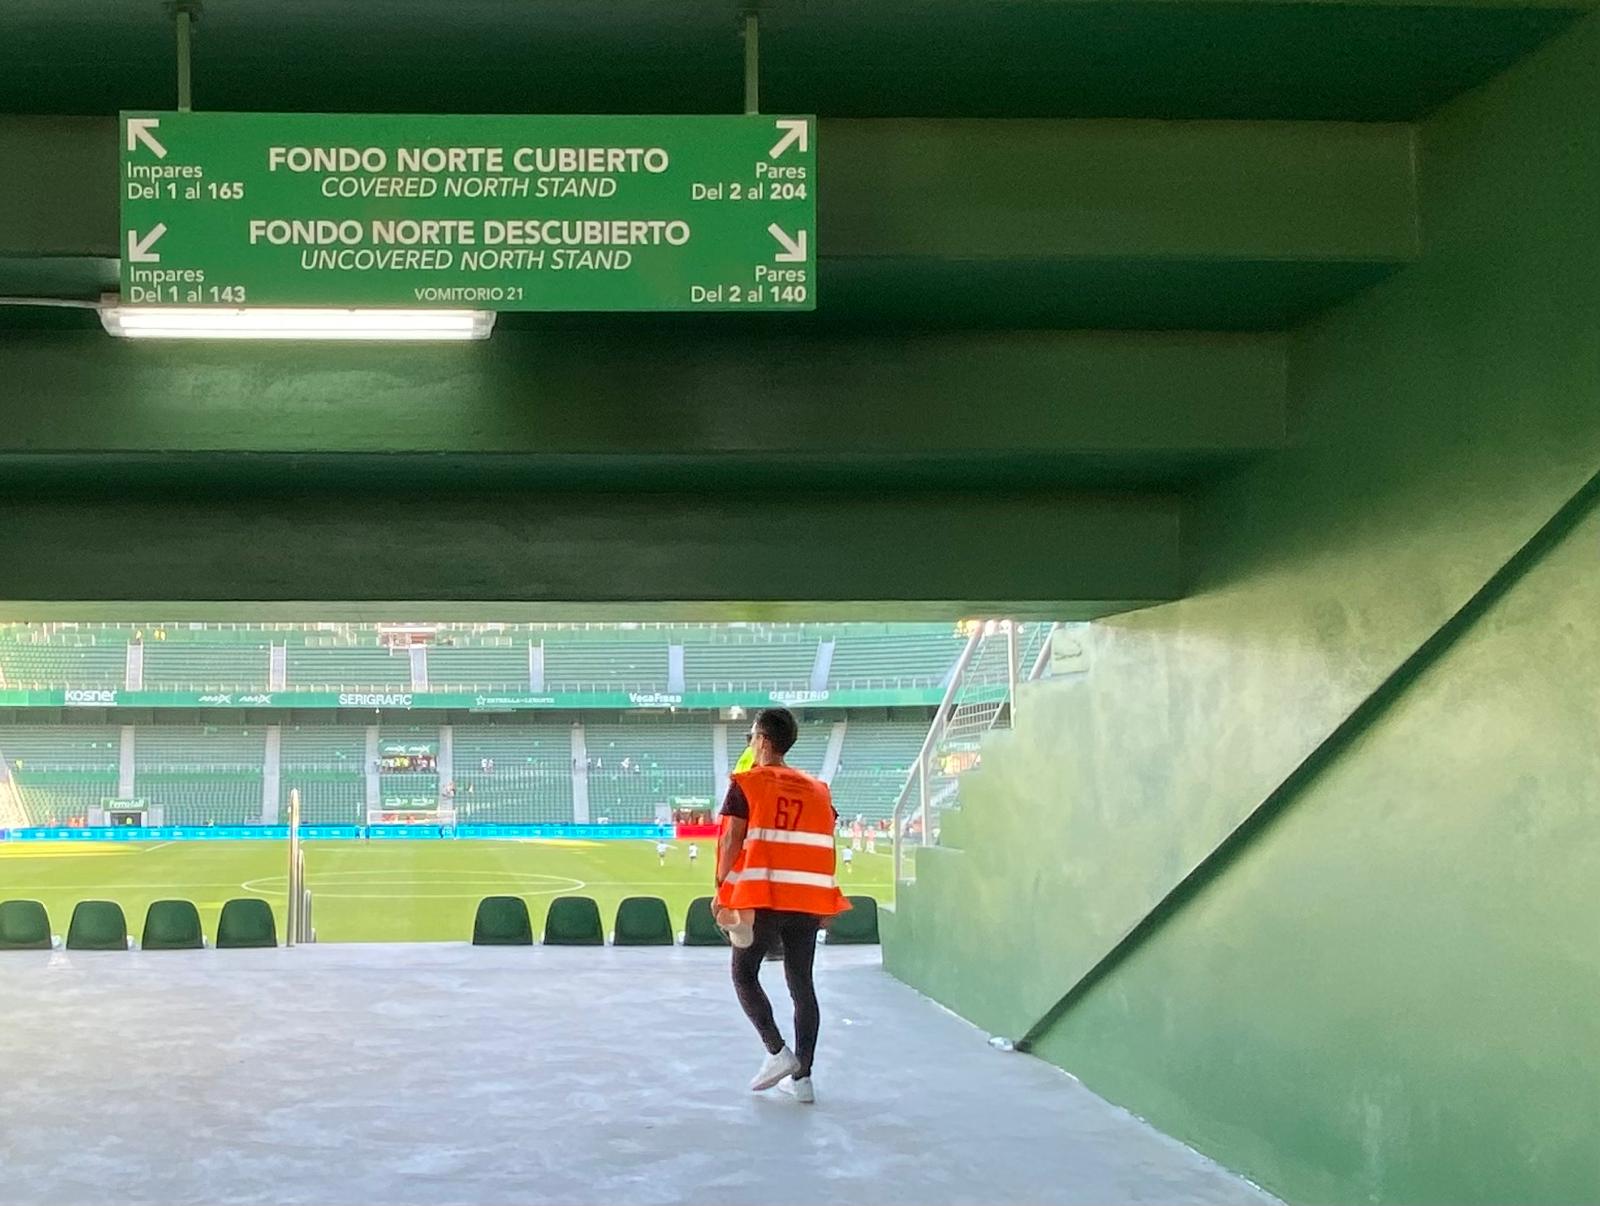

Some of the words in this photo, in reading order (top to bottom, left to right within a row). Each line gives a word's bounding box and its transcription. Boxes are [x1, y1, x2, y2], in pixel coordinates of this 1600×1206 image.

[270, 148, 386, 172] FONDO
[398, 148, 503, 172] NORTE
[514, 148, 668, 172] CUBIERTO
[128, 162, 202, 182] Impares
[756, 162, 806, 179] Pares
[128, 181, 159, 199] Del
[167, 183, 176, 199] 1
[185, 181, 200, 199] al
[208, 183, 243, 199] 165
[322, 177, 437, 197] COVERED
[445, 178, 529, 197] NORTH
[536, 177, 616, 197] STAND
[693, 183, 722, 200] Del
[730, 183, 741, 199] 2
[748, 183, 763, 199] al
[771, 183, 806, 199] 204
[250, 220, 363, 244] FONDO
[373, 220, 475, 244] NORTE
[485, 220, 689, 245] DESCUBIERTO
[302, 250, 452, 269] UNCOVERED
[461, 250, 544, 270] NORTH
[551, 249, 631, 269] STAND
[131, 266, 204, 286] Impares
[756, 266, 805, 282] Pares
[129, 284, 162, 304] Del
[167, 286, 179, 304] 1
[187, 285, 202, 303] al
[210, 286, 245, 303] 143
[415, 288, 503, 301] VOMITORIO
[507, 287, 522, 300] 21
[692, 286, 722, 302] Del
[729, 286, 740, 302] 2
[748, 286, 762, 302] al
[771, 286, 806, 302] 140
[64, 689, 117, 701] kosner
[339, 693, 412, 705] SERIGRAFIC
[775, 796, 803, 831] 67
